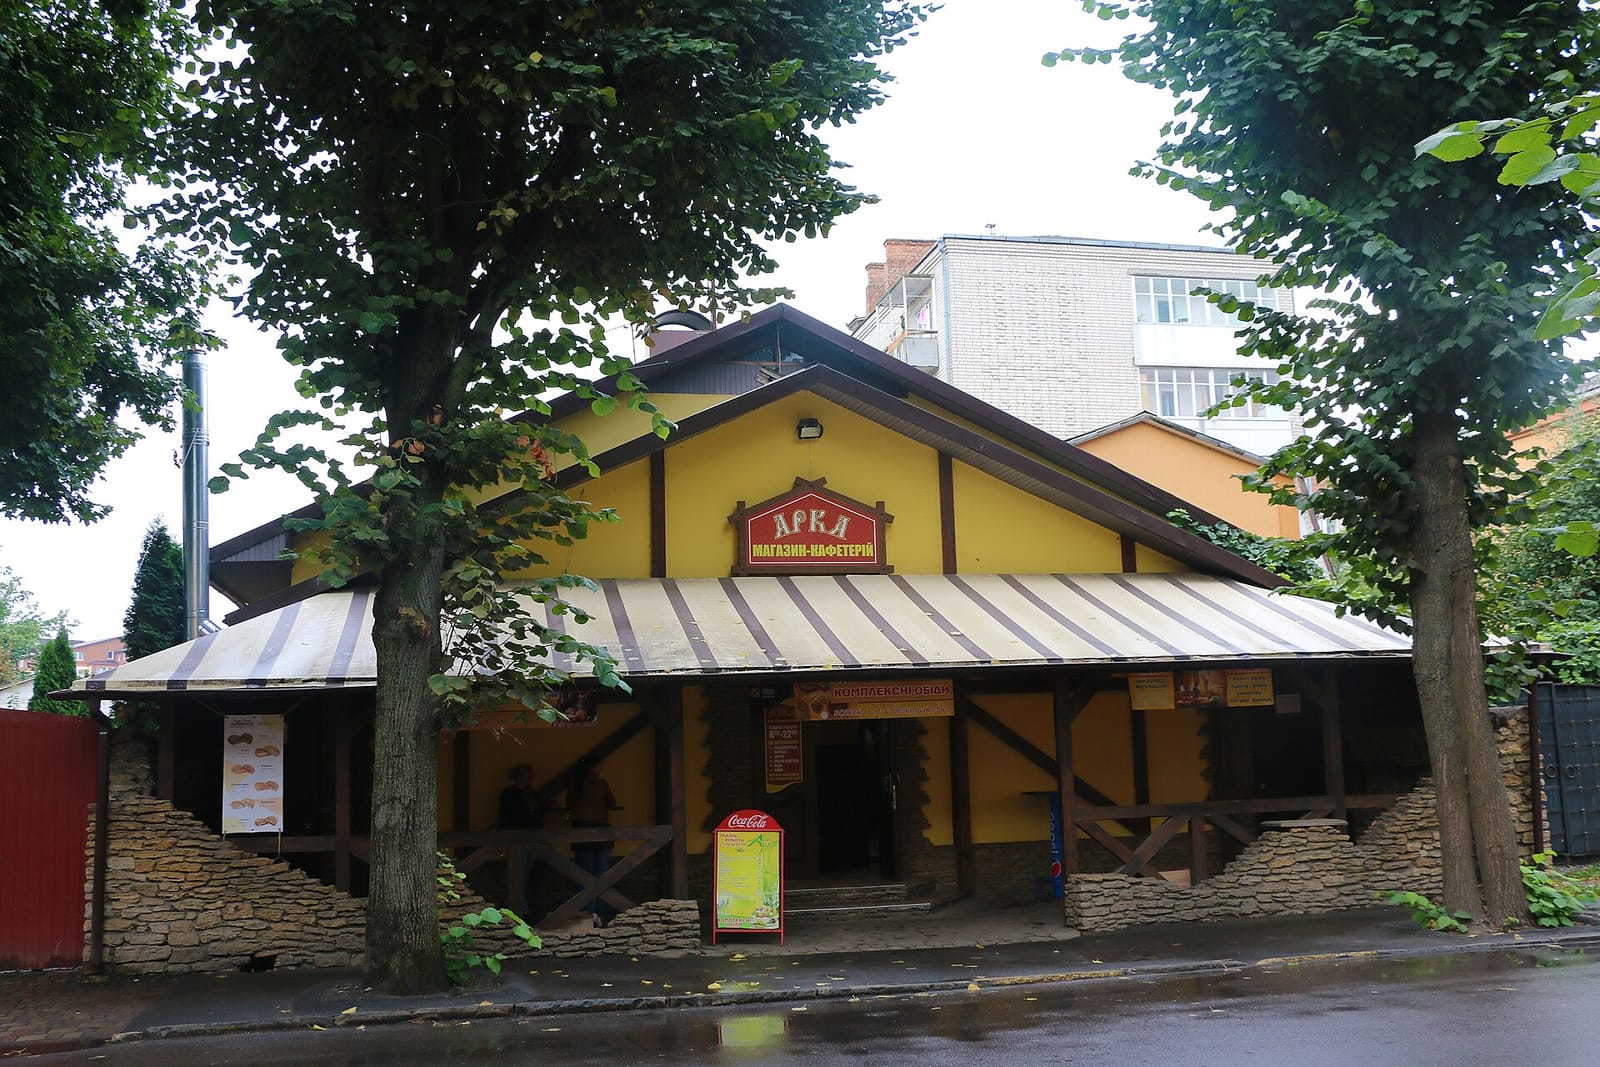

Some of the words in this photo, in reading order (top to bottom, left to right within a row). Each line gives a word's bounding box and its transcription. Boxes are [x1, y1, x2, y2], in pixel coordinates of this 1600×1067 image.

[772, 508, 852, 541] АРКА
[751, 541, 874, 558] МАГАЗИН-КАФЕТЕРІЙ
[833, 686, 912, 698] КОМПЛЕКСНІ
[914, 685, 950, 696] ОБІДИ
[728, 814, 769, 829] Coca-Cola
